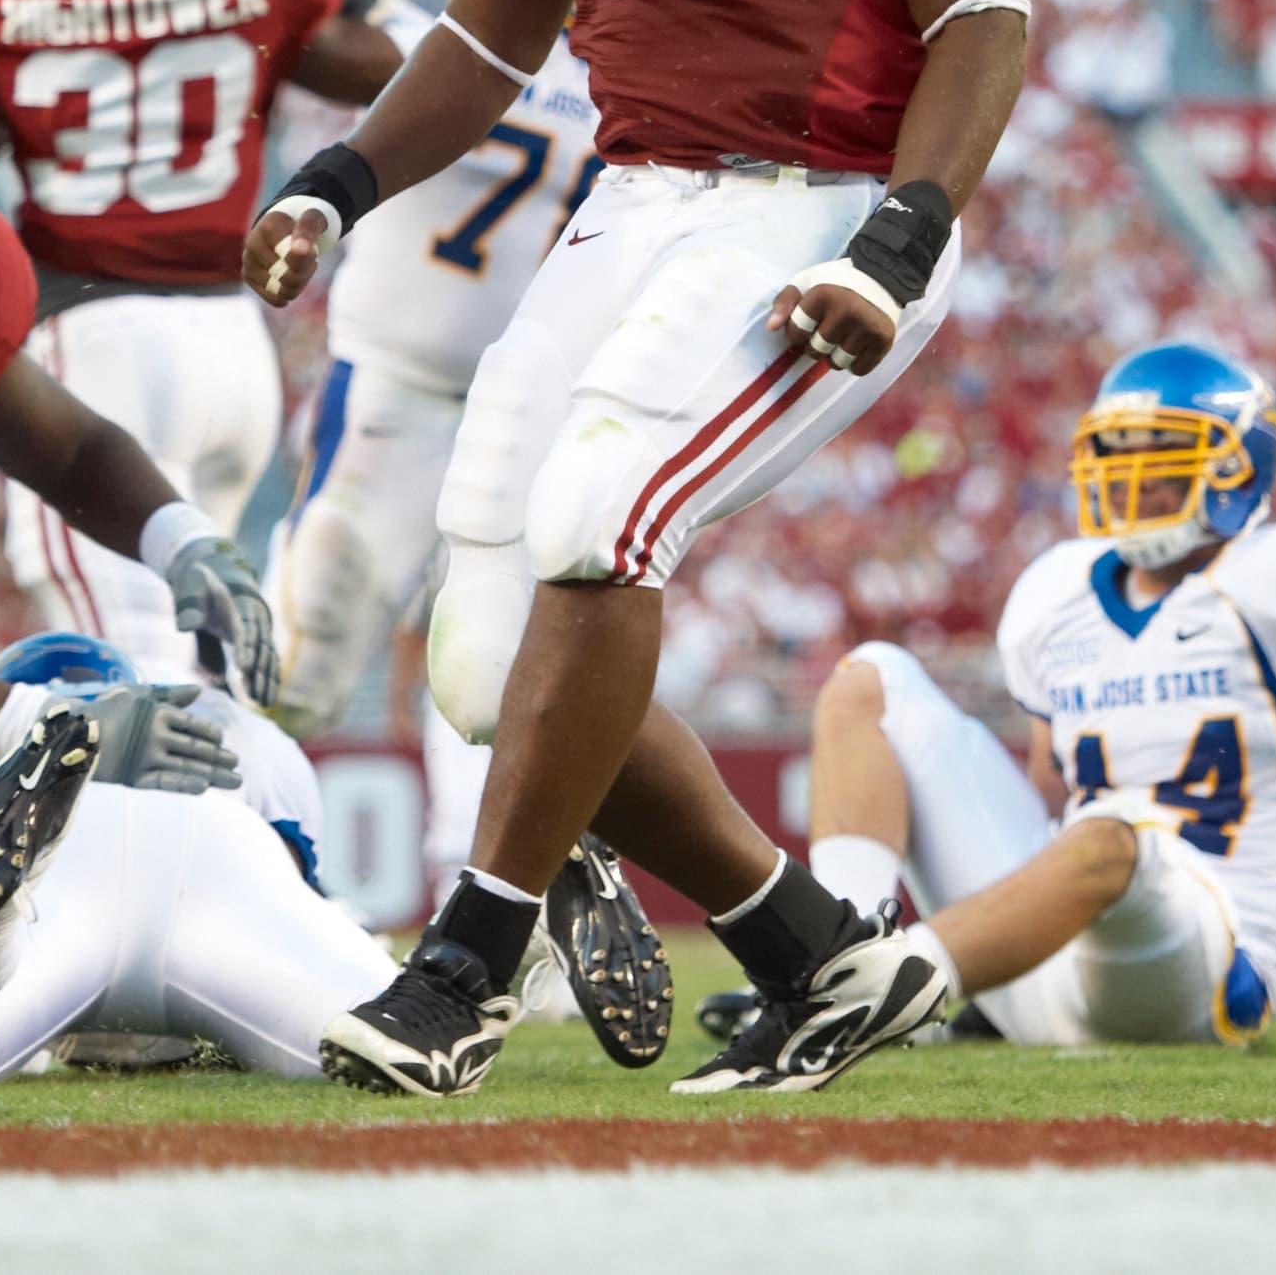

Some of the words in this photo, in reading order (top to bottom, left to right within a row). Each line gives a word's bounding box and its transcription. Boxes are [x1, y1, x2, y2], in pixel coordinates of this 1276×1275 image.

[13, 34, 258, 216] 30
[1049, 685, 1086, 713] SAN
[1093, 675, 1146, 710] JOSE
[1154, 666, 1232, 703] STATE
